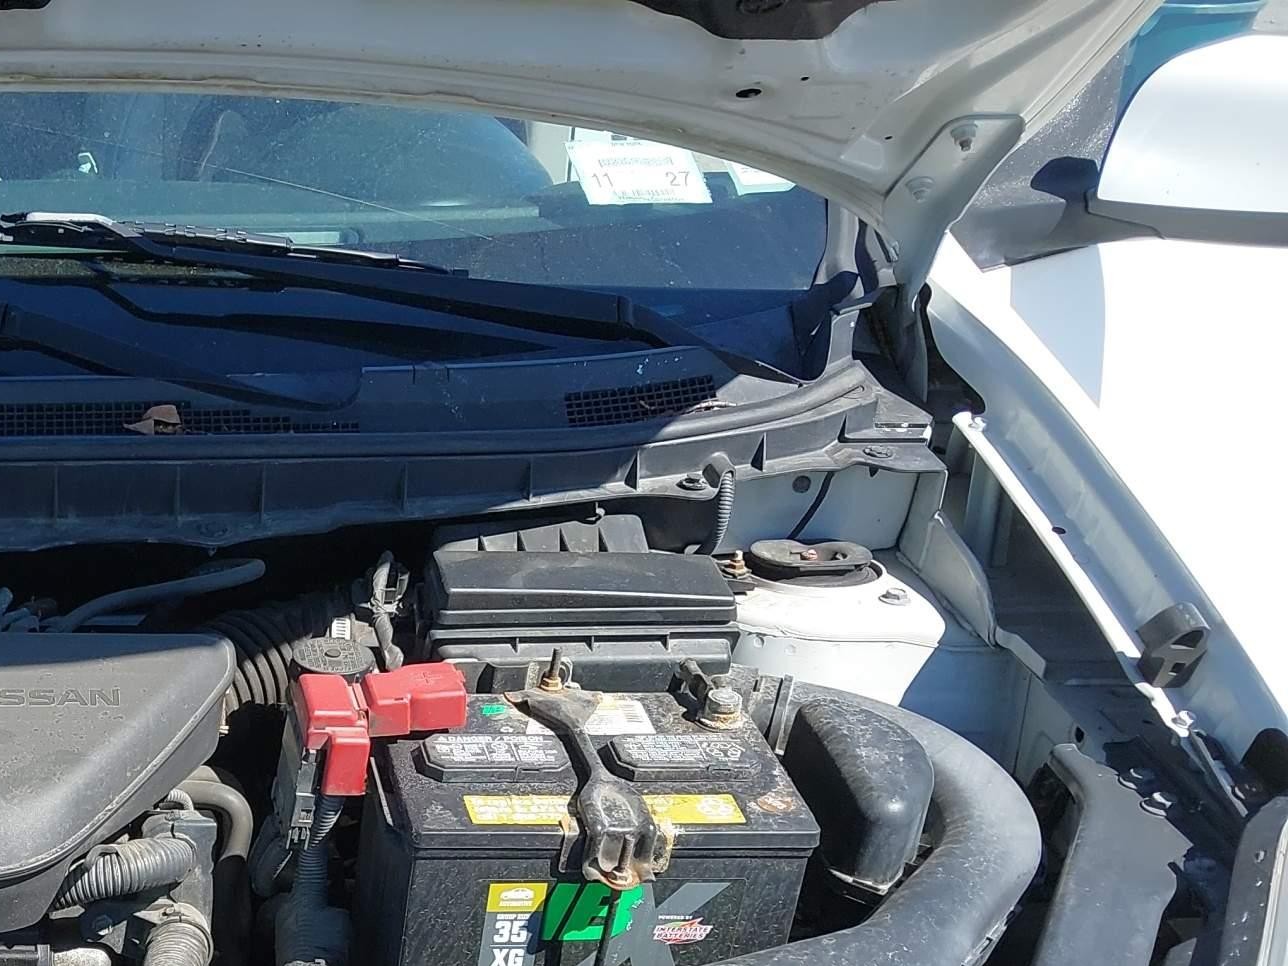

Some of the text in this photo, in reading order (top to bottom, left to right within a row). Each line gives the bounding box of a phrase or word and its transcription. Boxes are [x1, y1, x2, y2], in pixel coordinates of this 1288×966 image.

[591, 171, 690, 188] 11 27
[493, 920, 529, 943] 35
